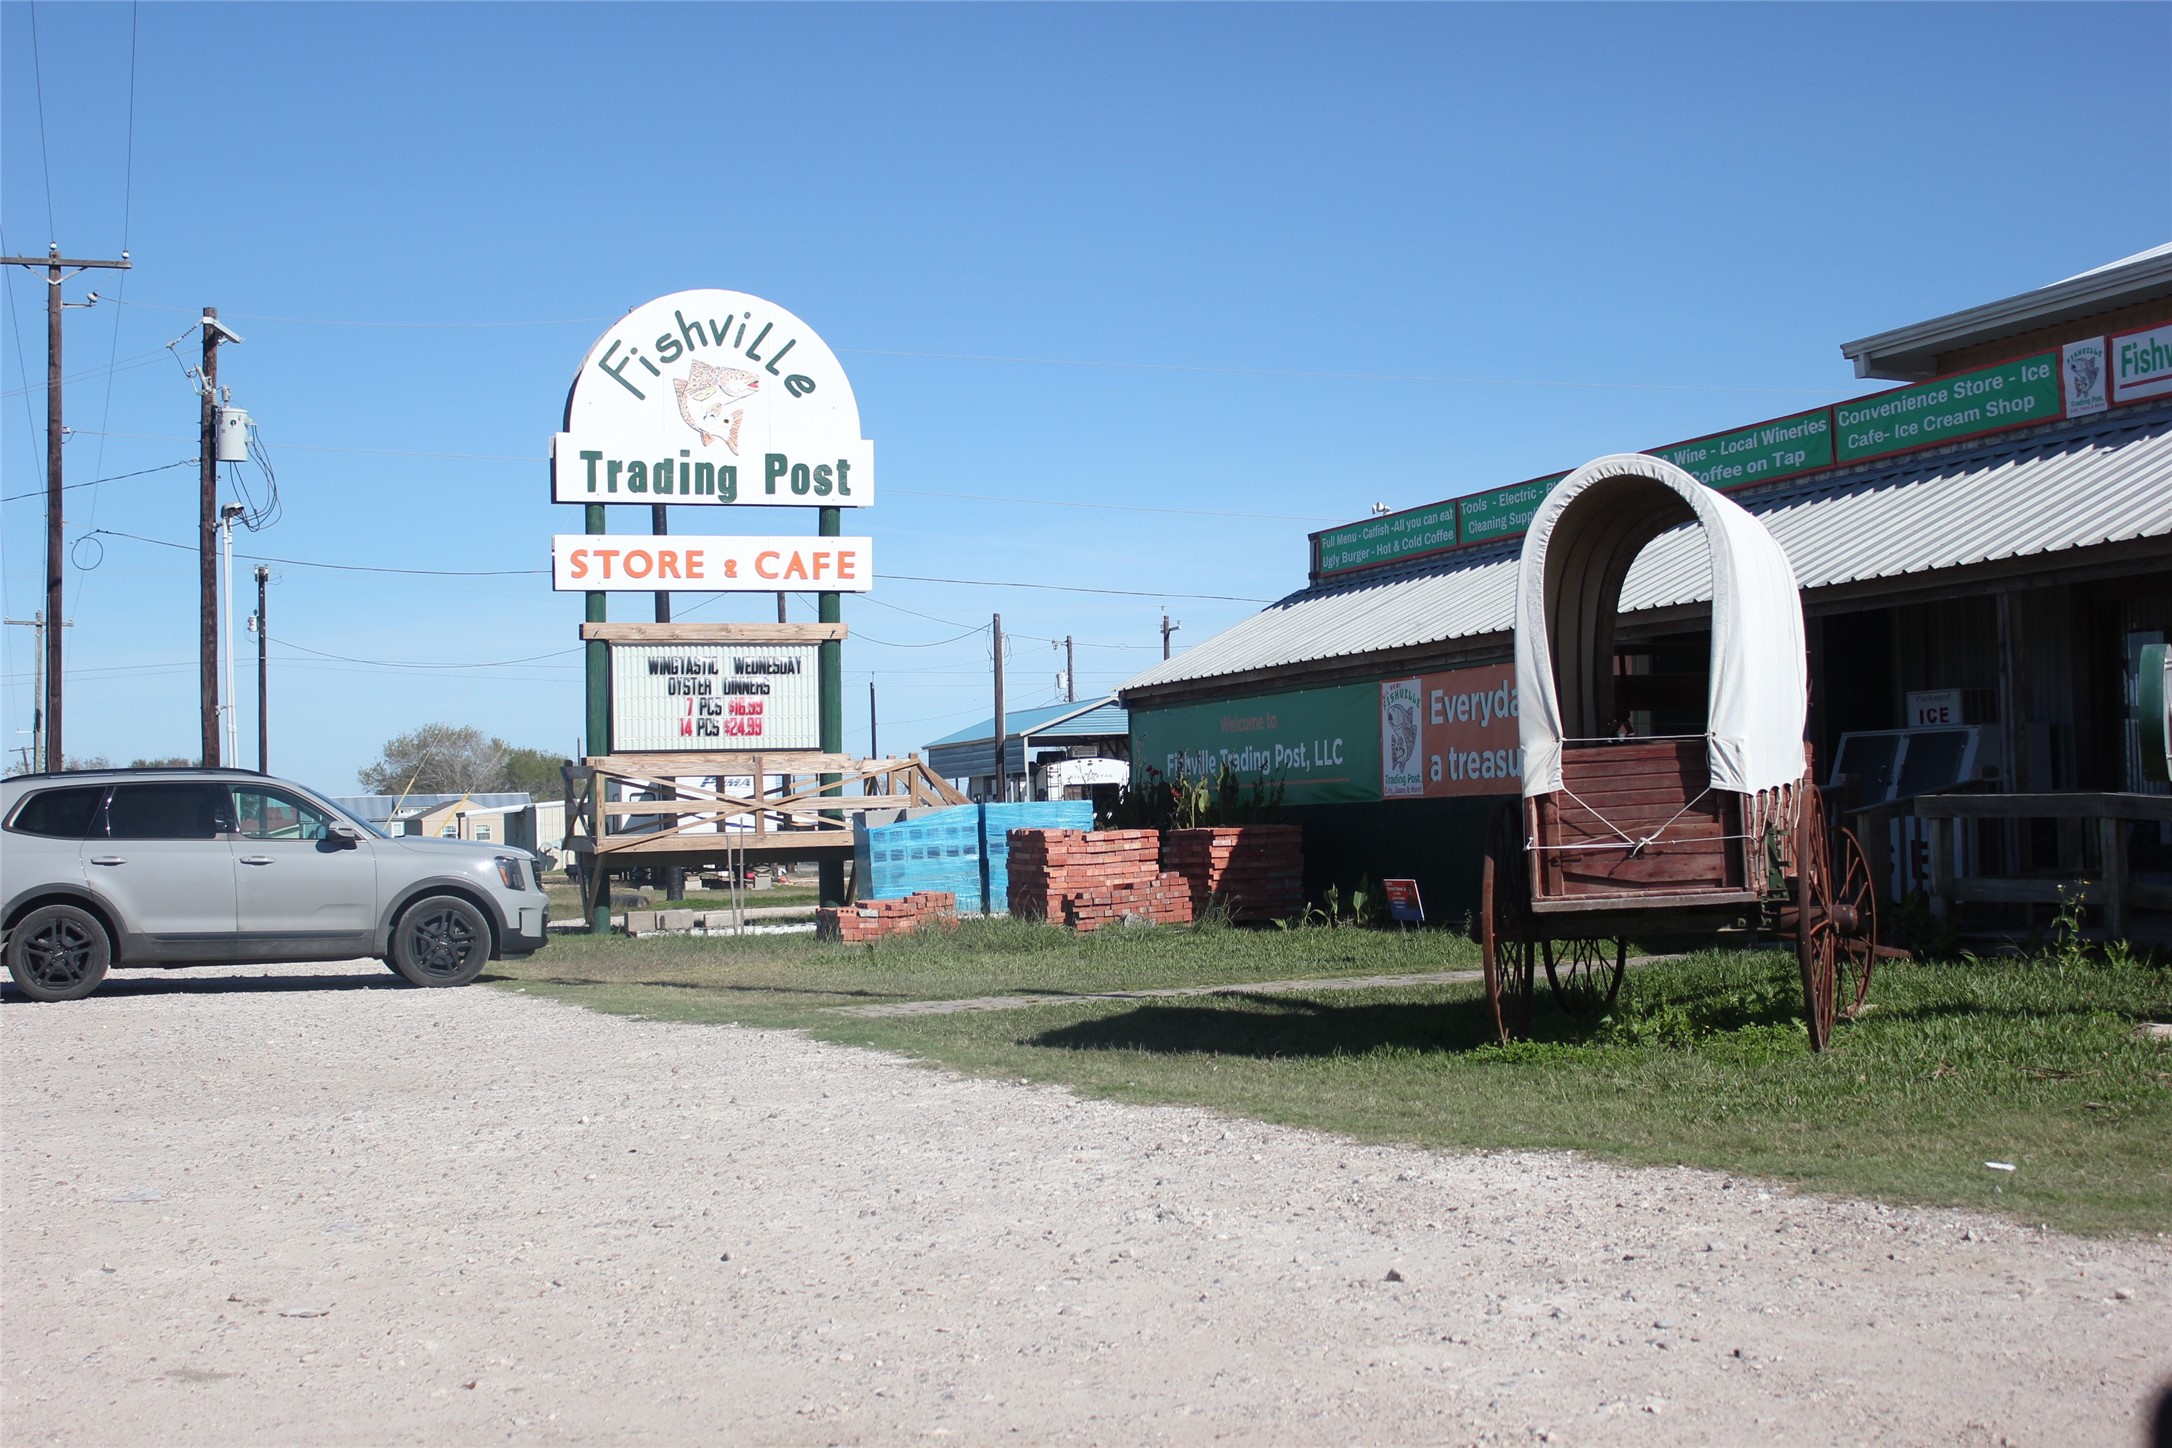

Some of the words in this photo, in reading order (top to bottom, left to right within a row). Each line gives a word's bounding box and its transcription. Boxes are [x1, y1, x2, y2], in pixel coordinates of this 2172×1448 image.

[1838, 389, 1948, 426] Convenience
[1953, 375, 2003, 398] Store
[2021, 364, 2050, 383] Ice
[1894, 422, 1918, 438] Ice
[1923, 407, 1980, 431] Cream
[1986, 395, 2035, 417] Shop
[1674, 448, 1706, 466] Wine
[1720, 432, 1758, 456] Local
[1761, 420, 1827, 446] Wineries
[1746, 459, 1767, 473] on
[1772, 450, 1806, 467] Tap
[579, 449, 738, 503] Trading
[764, 453, 851, 496] Post
[1461, 498, 1487, 515] Tools
[1499, 487, 1537, 507] Electric
[1322, 534, 1335, 549] Full
[1337, 532, 1357, 545] Menu
[1362, 522, 1389, 540] Catfish
[1406, 517, 1421, 532] you
[1424, 514, 1438, 525] can
[1440, 508, 1453, 521] eat
[1468, 515, 1507, 534] Cleaning
[1322, 553, 1340, 568] Ugly
[1342, 548, 1369, 563] Burger
[1376, 544, 1391, 556] Hot
[1393, 540, 1400, 552] &
[1402, 535, 1422, 549] Cold
[1424, 530, 1454, 545] Coffee
[570, 549, 704, 579] STORE
[724, 559, 738, 578] &
[755, 551, 856, 580] CAFE
[648, 656, 719, 675] WINGTASTIC
[733, 656, 802, 675] WEDNESDAY
[668, 677, 712, 696] OYSTER
[723, 677, 770, 696] DINNERS
[1383, 688, 1420, 710] FISHVILLE
[686, 698, 694, 716] 7
[699, 698, 722, 716] PCS
[1430, 680, 1519, 727] Everyda
[1920, 706, 1949, 724] ICE
[680, 718, 692, 736] 14
[696, 718, 720, 736] PCS
[724, 718, 762, 736] $24.99
[1220, 716, 1264, 734] Welcome
[1266, 714, 1277, 730] to
[1220, 746, 1271, 776] Trading
[1275, 742, 1310, 772] Post,
[1314, 738, 1344, 766] LLC
[1430, 754, 1442, 782] a
[700, 776, 750, 788] PMA
[1385, 774, 1406, 786] Trading
[1408, 774, 1420, 784] Post
